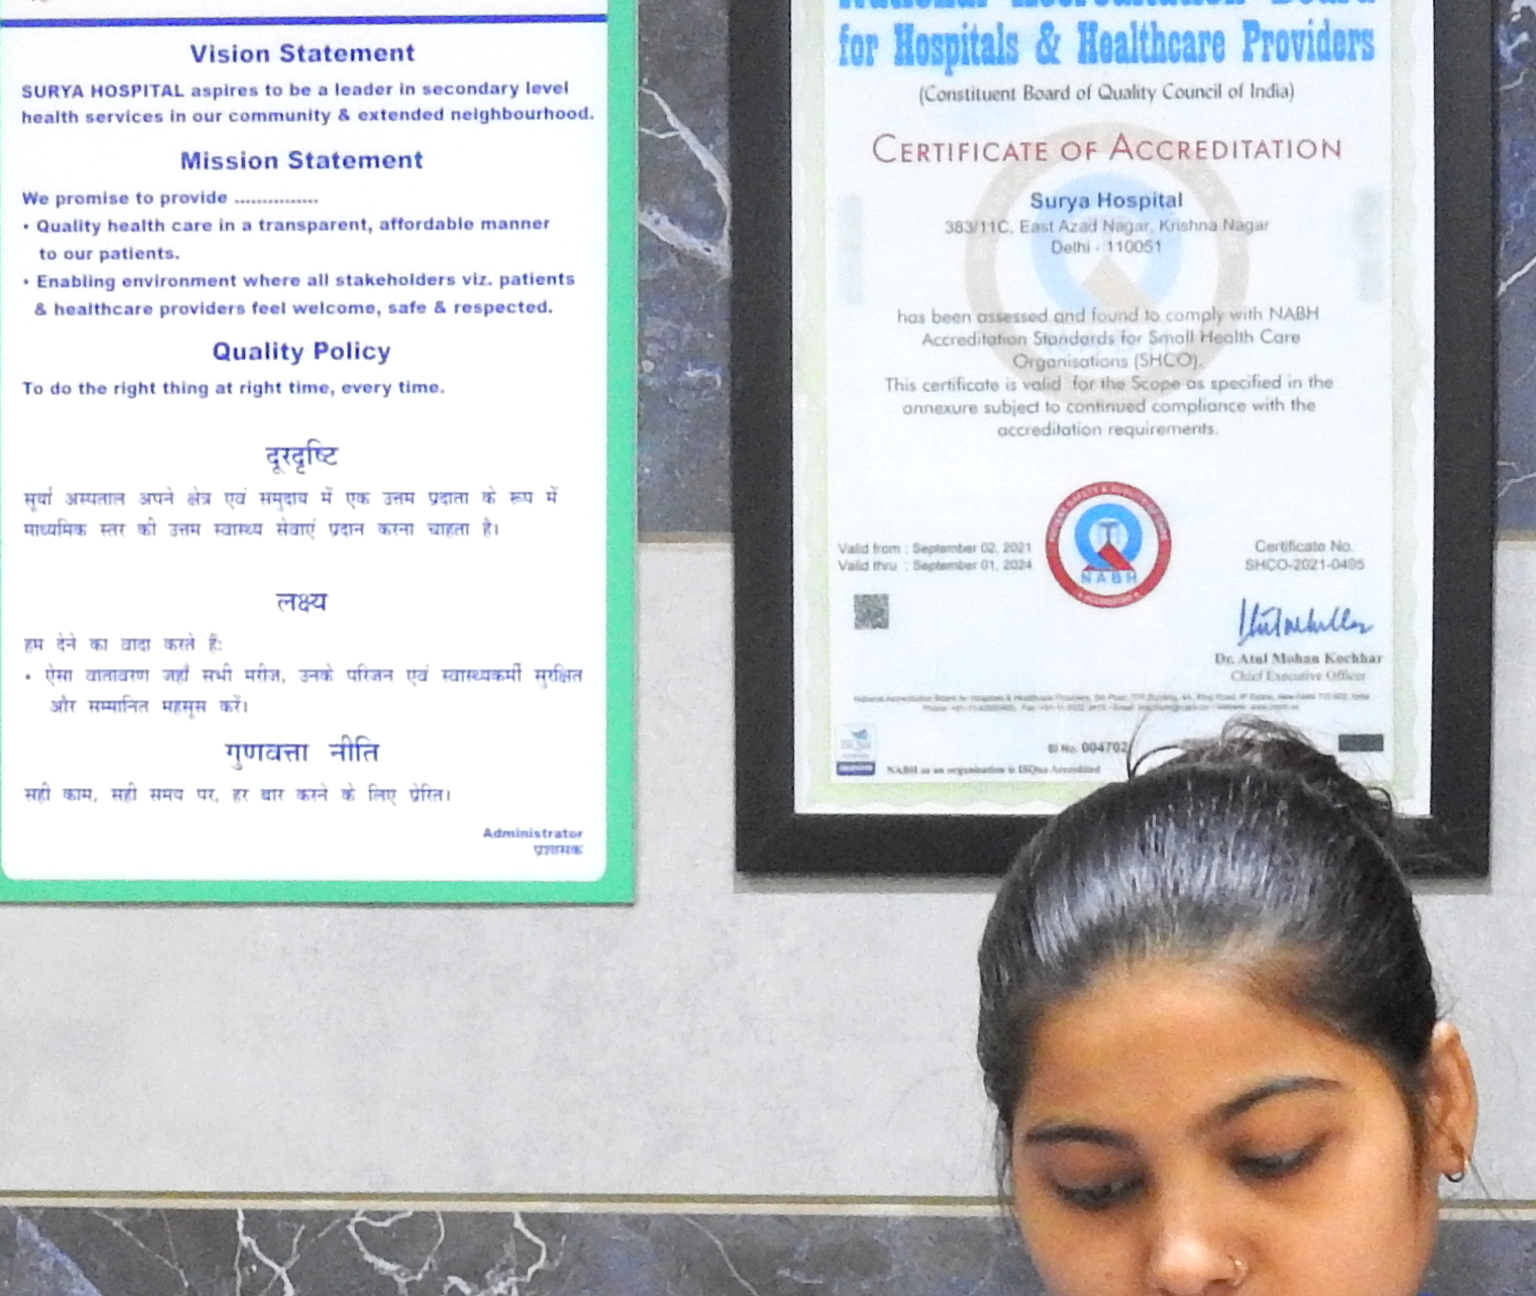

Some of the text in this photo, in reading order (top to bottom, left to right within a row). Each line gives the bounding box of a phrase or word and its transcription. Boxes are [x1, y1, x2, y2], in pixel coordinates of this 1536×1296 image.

[190, 42, 415, 65] Vision Statement
[838, 17, 1376, 78] for Hospitals & Healthcare Providers
[21, 80, 569, 102] SURYA HOSPITAL aspires to be a leader in secondary level
[919, 81, 1295, 107] (Constituent Board of Quality Council of India)
[21, 105, 595, 127] health services in our community & extended neighbourhood.
[872, 130, 1342, 164] CERTIFICATE OF ACCREDITATION
[180, 149, 424, 172] Mission Statement
[1030, 190, 1183, 215] Surya Hospital
[36, 215, 551, 238] Quality health care in a transparent, affordable manner
[38, 245, 180, 264] to our patients.
[1050, 238, 1091, 256] Delhi
[1106, 238, 1162, 255] 110051
[897, 304, 1320, 329] has been assessed and found to comply with NABH
[921, 327, 1301, 349] Accreditation Standards for Small Health Care
[212, 340, 391, 367] Quality Policy
[22, 379, 445, 400] To do the right thing at right time, every time.
[264, 437, 340, 476] दूरदृष्टि
[275, 591, 329, 613] लक्ष्य
[224, 733, 381, 772] गुणवत्ता नीति
[482, 826, 584, 840] Administrator
